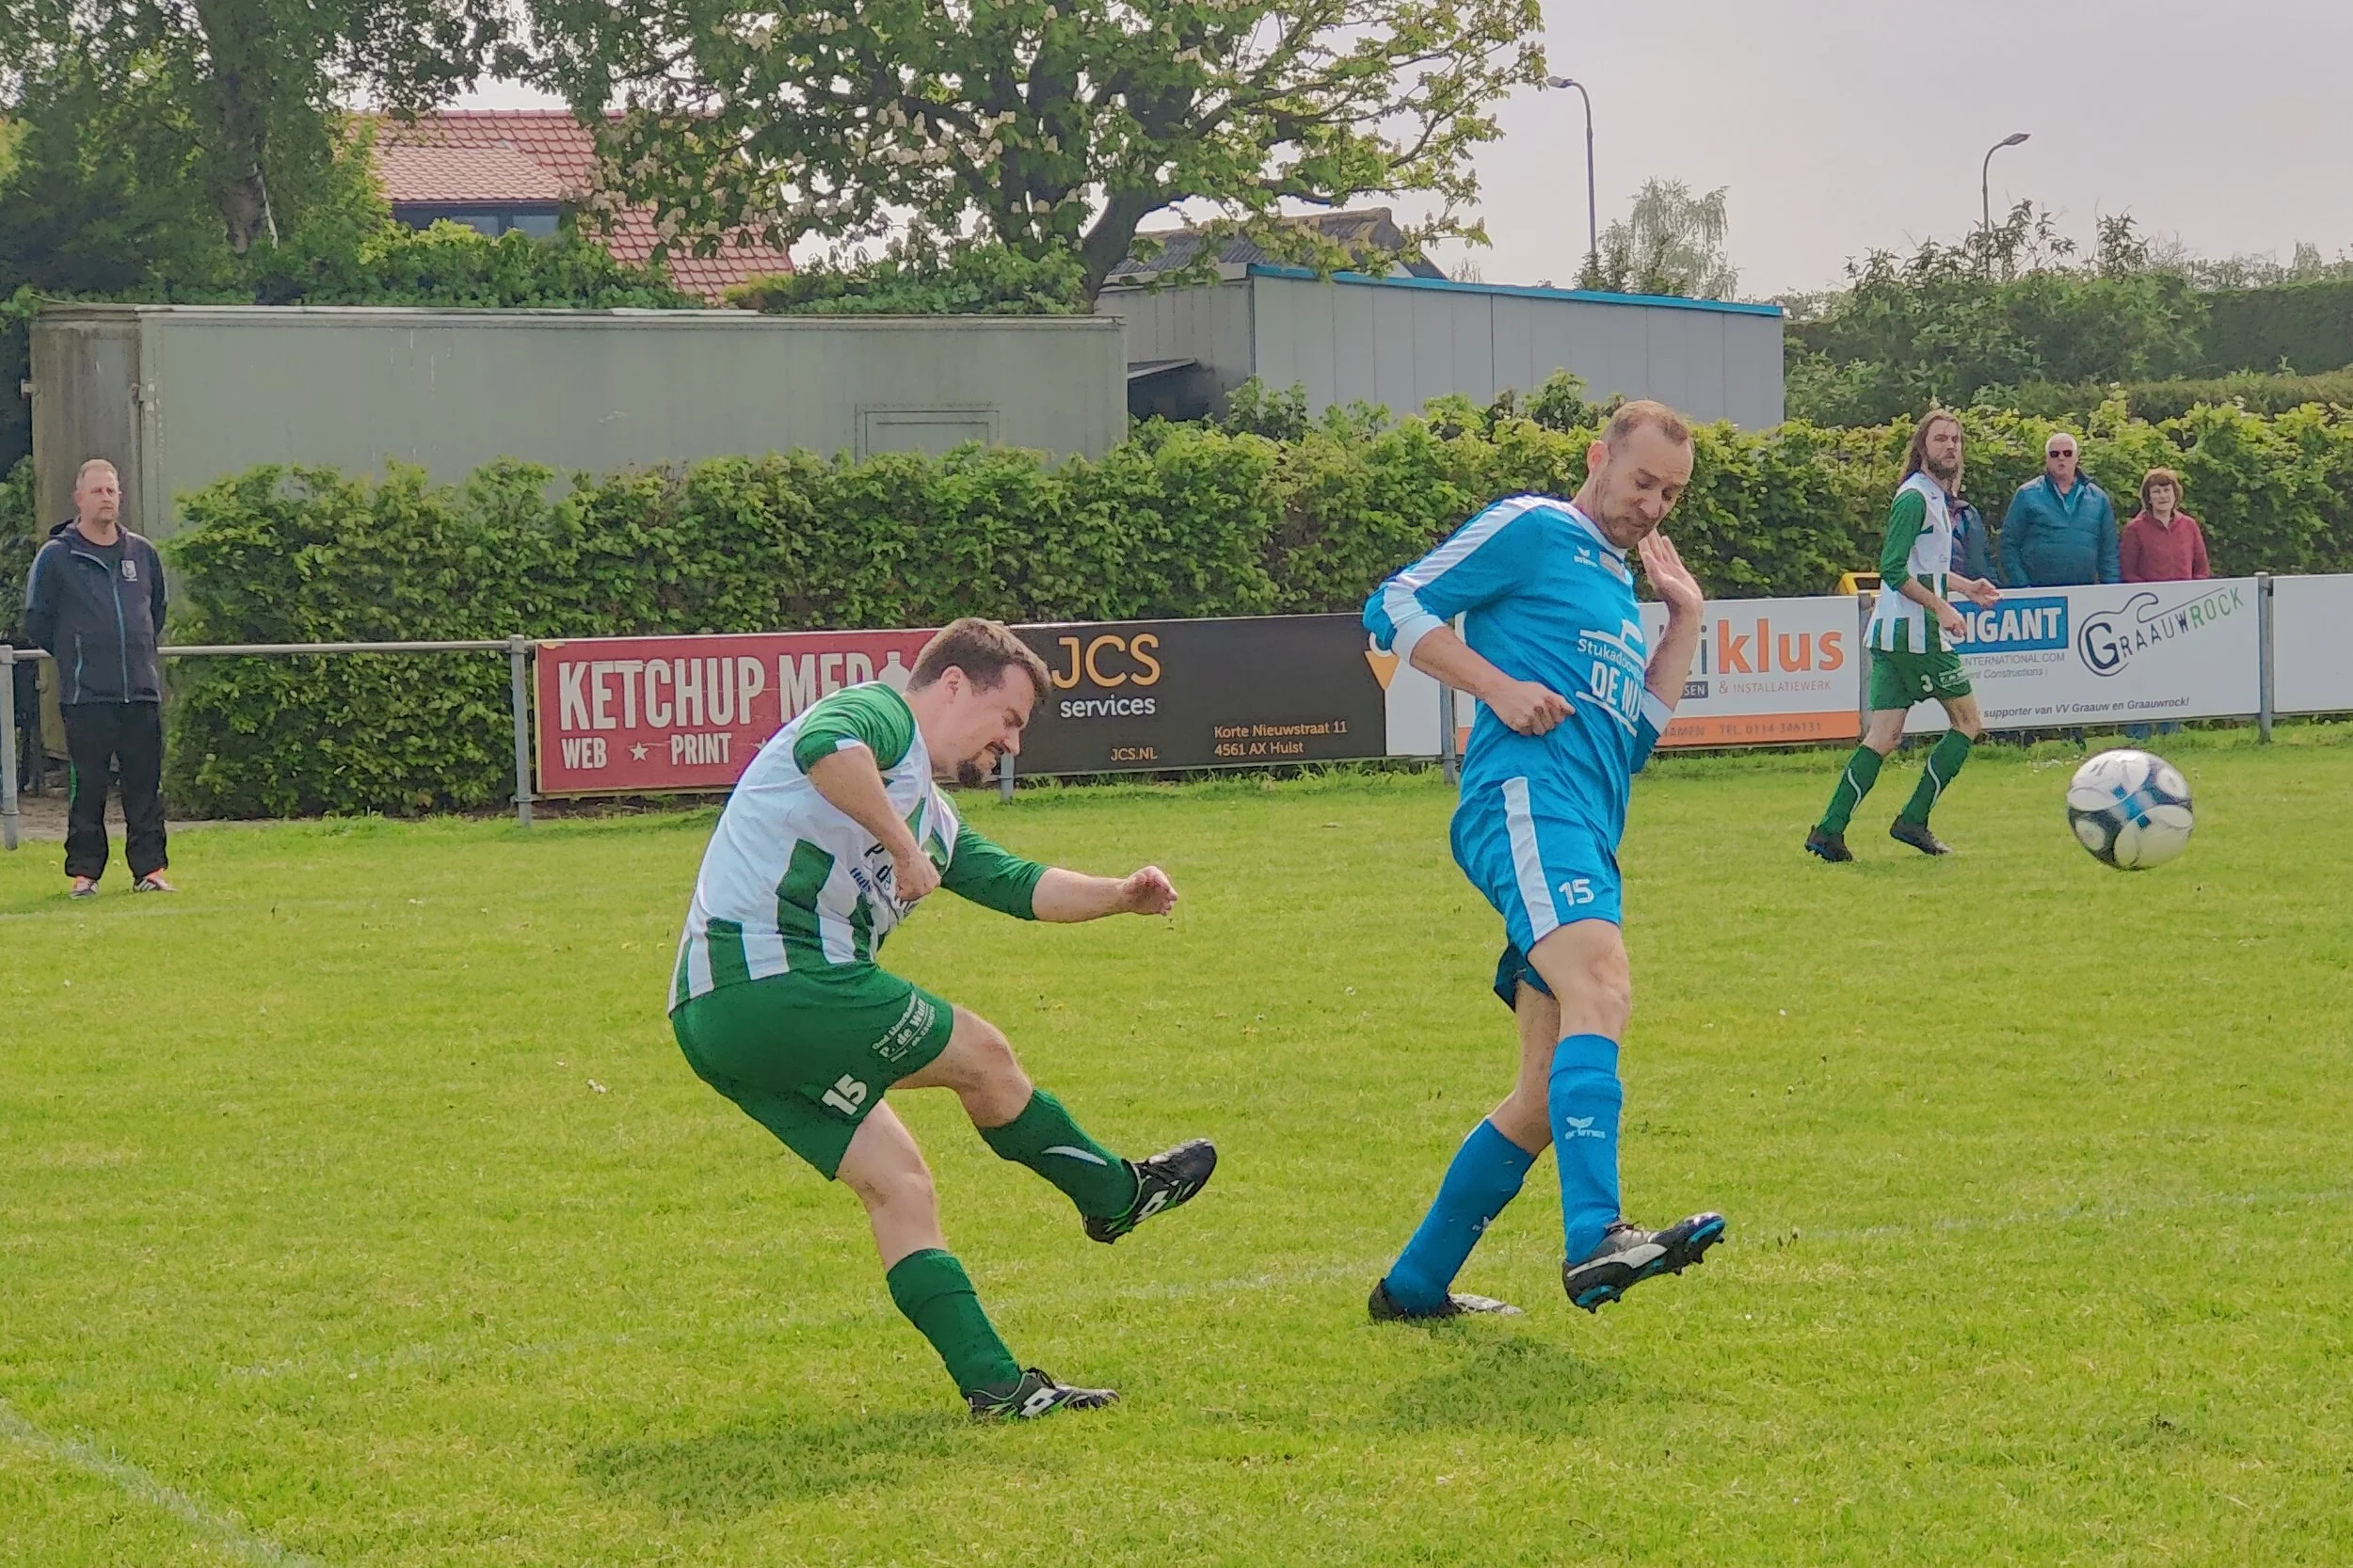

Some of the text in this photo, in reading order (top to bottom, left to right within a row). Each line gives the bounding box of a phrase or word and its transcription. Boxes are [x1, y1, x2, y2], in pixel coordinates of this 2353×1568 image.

[1659, 618, 1845, 675] iklus
[1051, 632, 1161, 690] JCS
[558, 657, 765, 730] KETCHUP
[1683, 680, 1832, 696] SEN & INSTALLATIEWERK
[1920, 674, 1934, 693] 3
[1060, 694, 1157, 719] services
[1983, 707, 2031, 719] supporter
[2034, 706, 2053, 715] van
[2055, 704, 2071, 713] VV
[2072, 702, 2109, 712] Graauw
[1214, 720, 1348, 738] Korte Nieuwstraat 11
[561, 731, 732, 770] WEB PRINT
[1110, 746, 1159, 761] JCS.NL
[1214, 740, 1305, 757] 4561 AX Hulst
[1558, 878, 1595, 907] 15
[821, 1073, 868, 1116] 15
